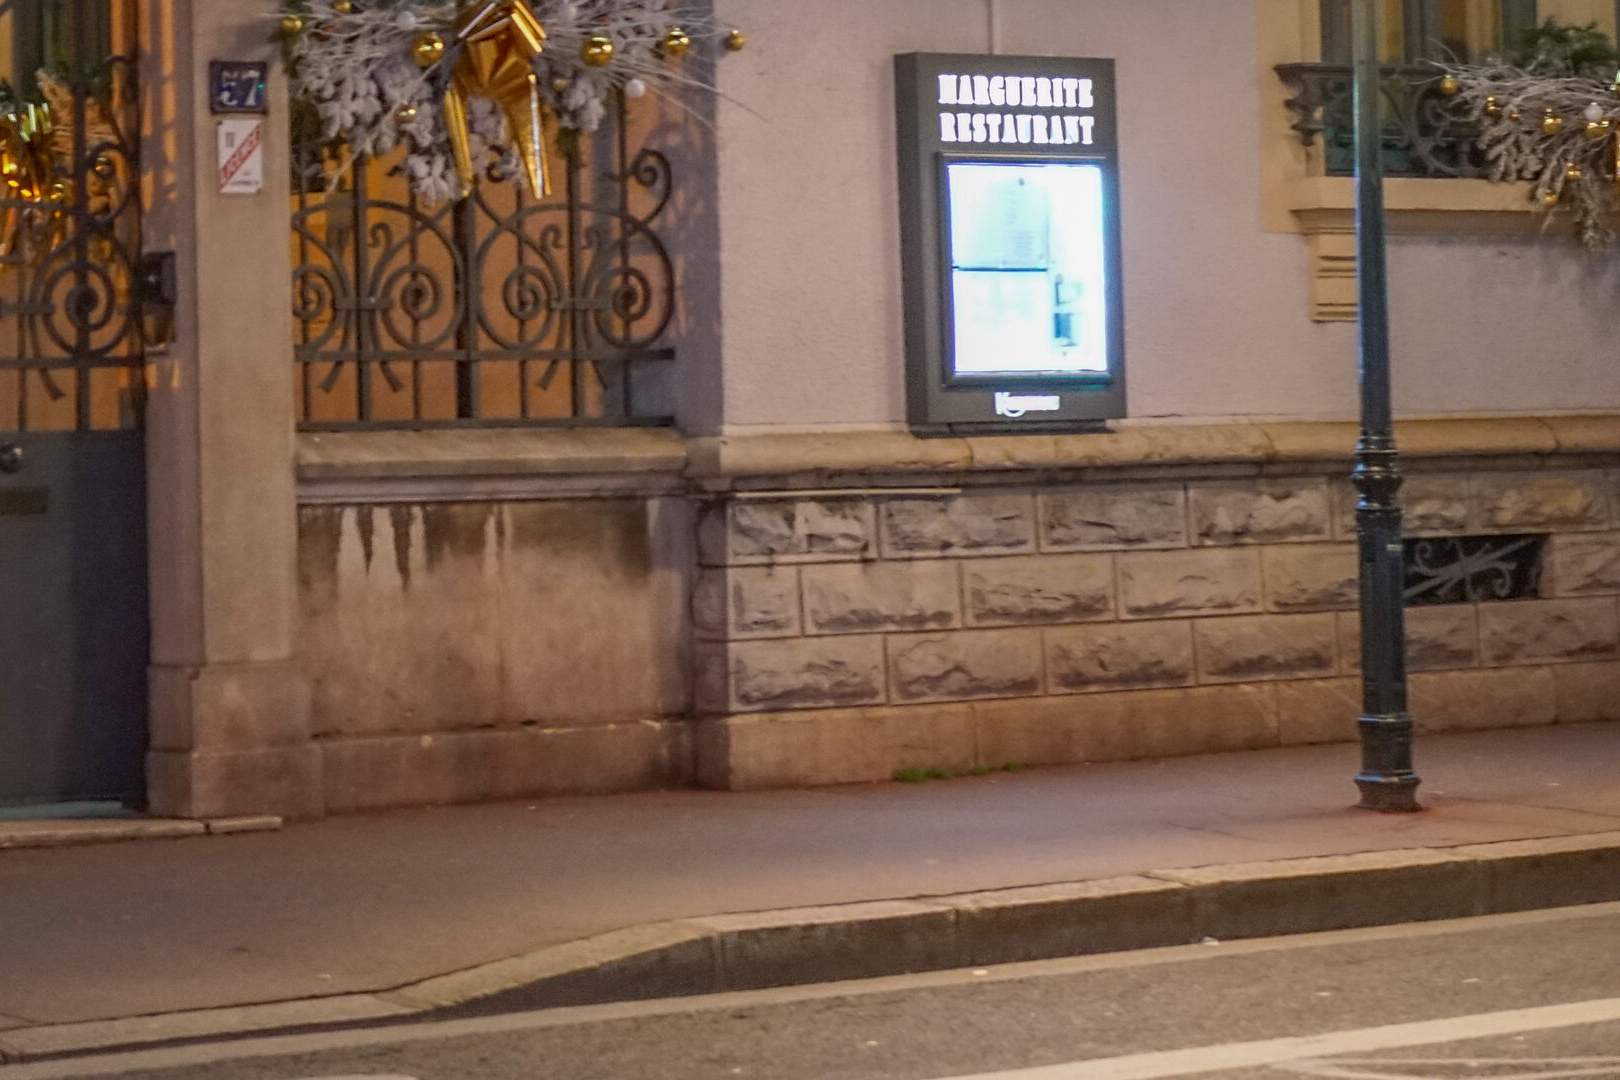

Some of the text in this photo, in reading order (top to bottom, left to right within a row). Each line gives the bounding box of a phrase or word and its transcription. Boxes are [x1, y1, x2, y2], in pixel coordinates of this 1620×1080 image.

[219, 70, 261, 107] 57
[937, 74, 1094, 108] MARGUERITE
[940, 112, 1095, 145] RESTAURANT
